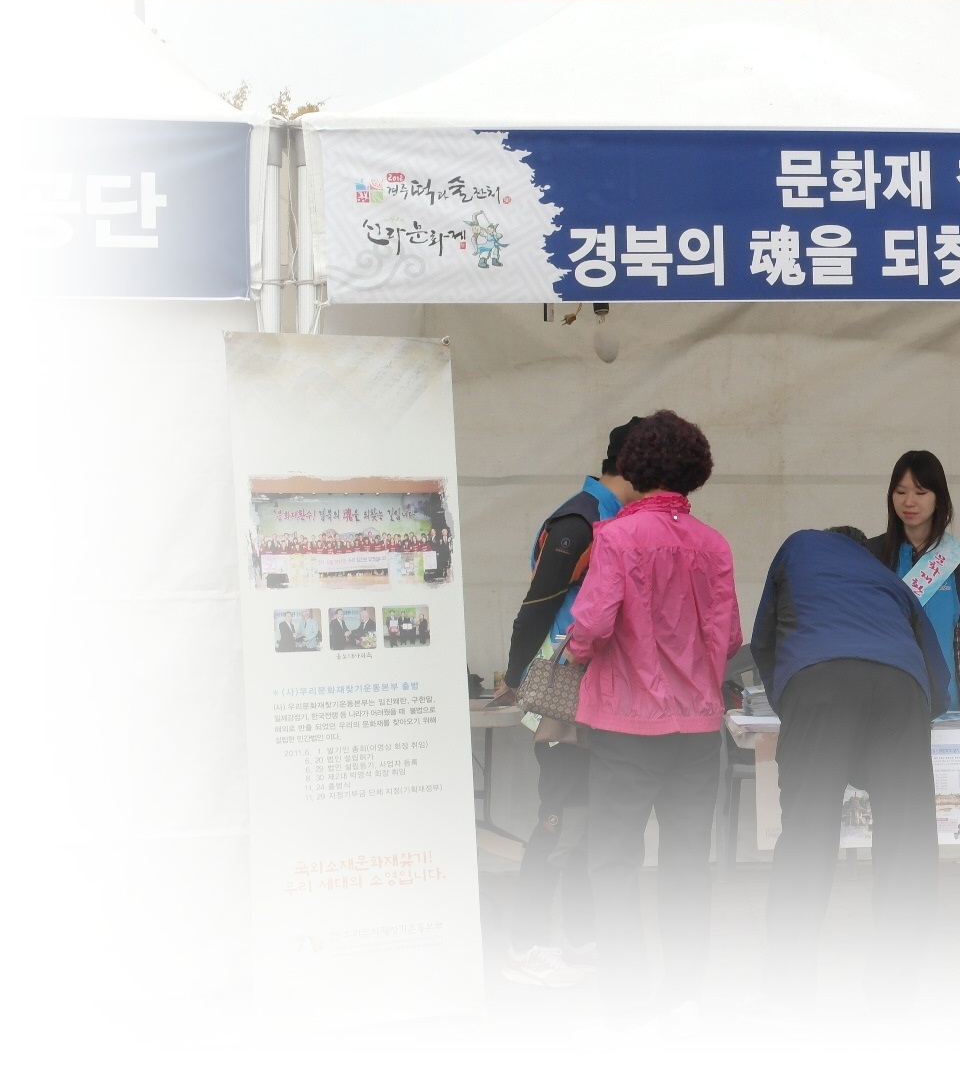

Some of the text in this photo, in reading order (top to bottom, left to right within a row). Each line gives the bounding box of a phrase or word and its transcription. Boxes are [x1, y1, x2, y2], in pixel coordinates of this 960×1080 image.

[776, 149, 931, 210] 문화재
[567, 223, 724, 288] 경북의
[749, 223, 858, 287] 魂을
[401, 681, 419, 692] 출범
[318, 875, 363, 893] 세대의
